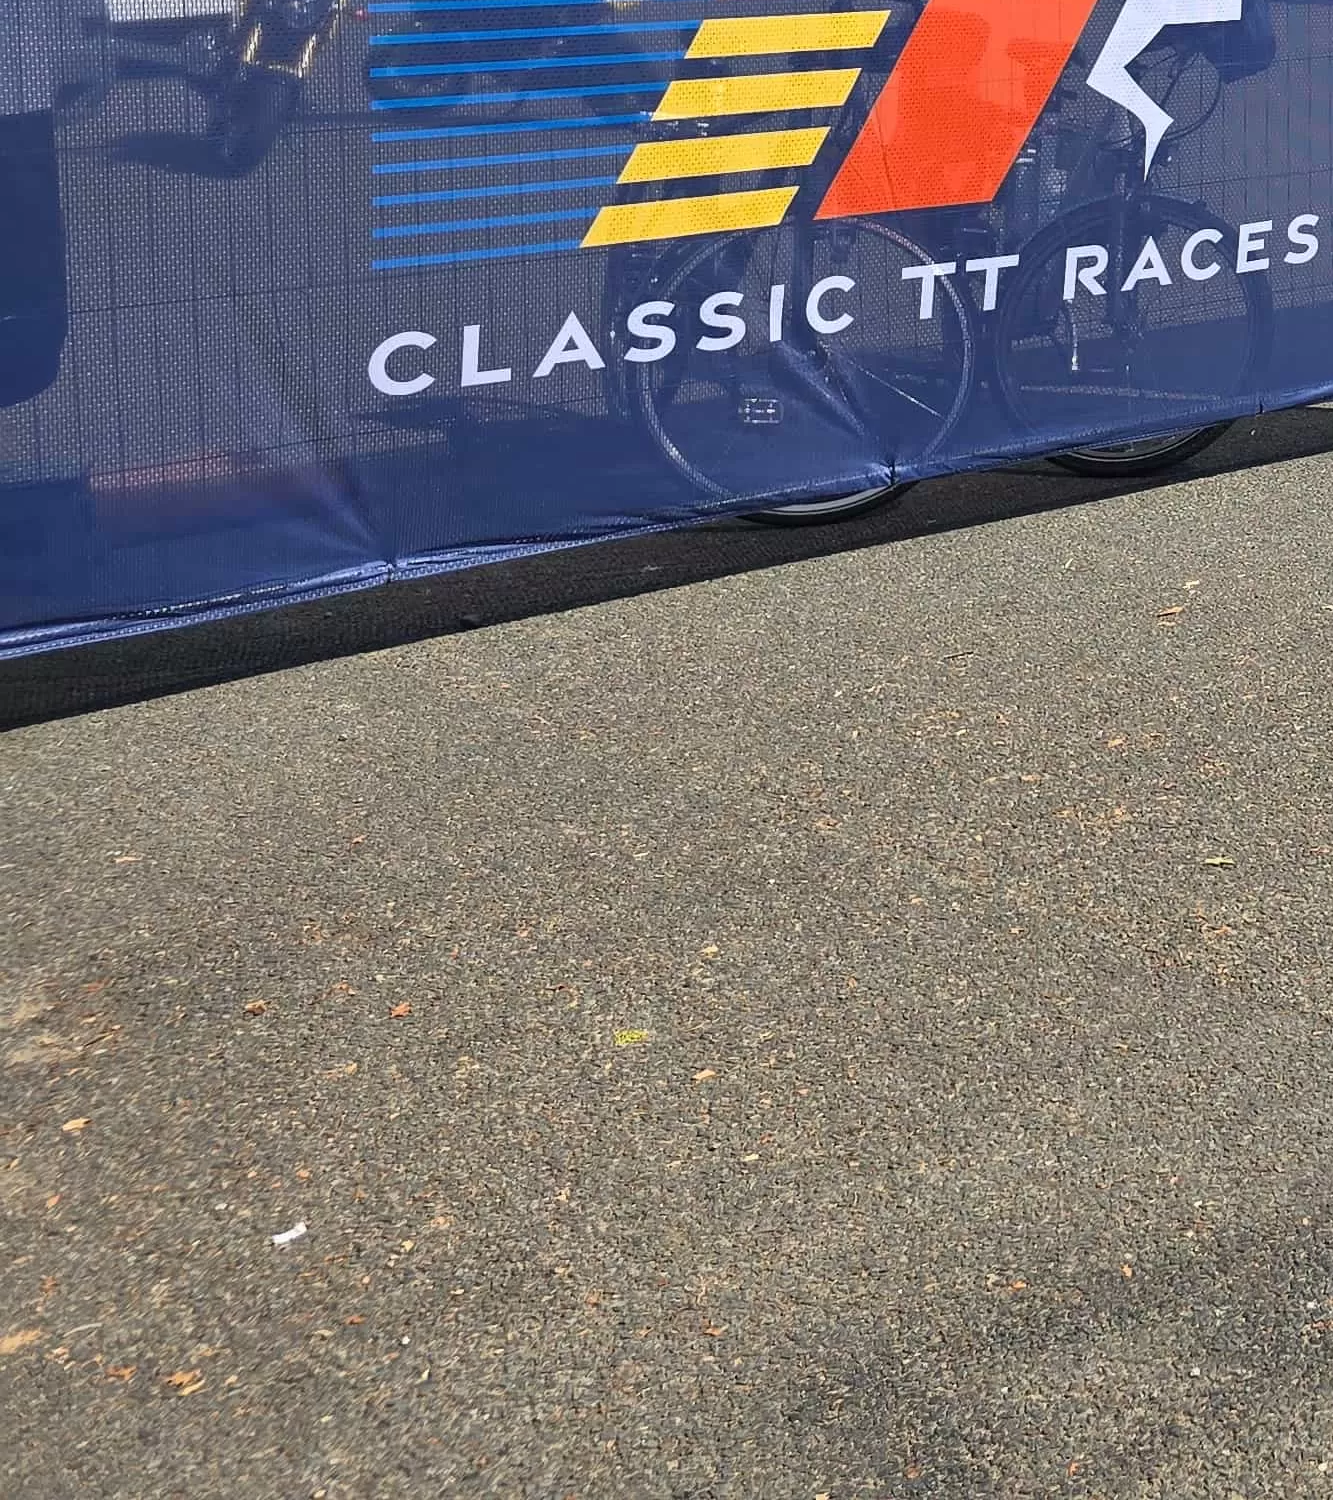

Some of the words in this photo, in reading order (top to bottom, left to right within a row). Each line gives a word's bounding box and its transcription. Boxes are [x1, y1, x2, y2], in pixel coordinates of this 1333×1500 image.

[367, 274, 855, 397] CLASSIC
[900, 254, 1020, 321] TT
[1062, 213, 1320, 302] RACES
